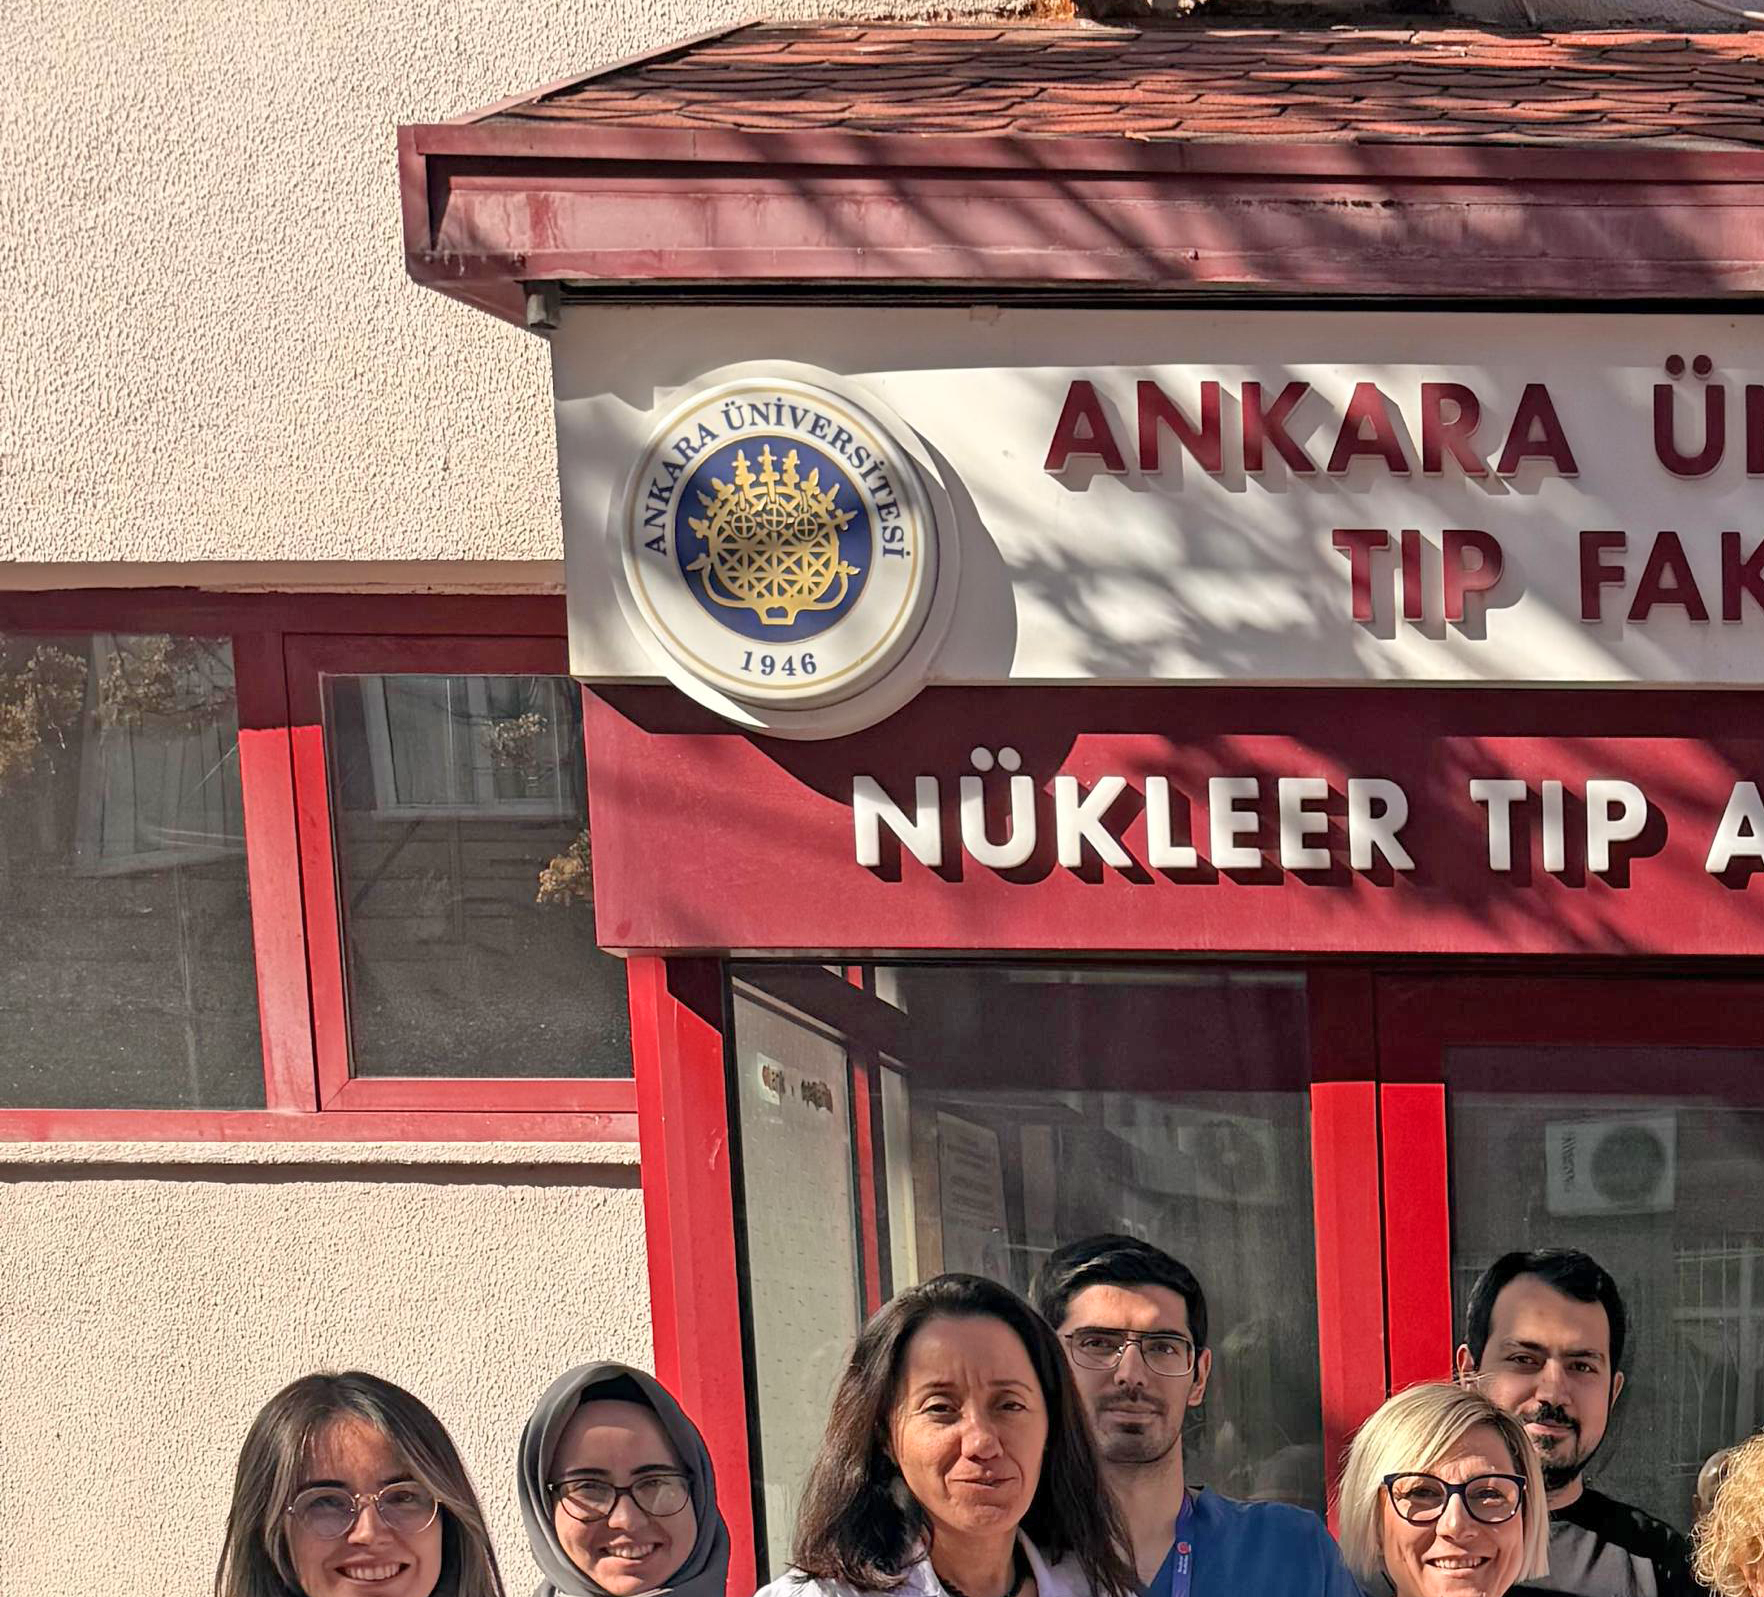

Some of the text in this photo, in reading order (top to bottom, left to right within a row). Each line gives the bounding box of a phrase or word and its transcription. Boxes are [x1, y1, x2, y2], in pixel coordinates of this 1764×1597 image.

[643, 396, 912, 560] ANKARA ÜNİVERSİTESİ
[1041, 379, 1581, 480] ANKARA
[1329, 527, 1505, 625] TIP
[740, 650, 818, 677] 1946
[852, 745, 1416, 873] NÜKLEER
[1468, 777, 1652, 875] TIP
